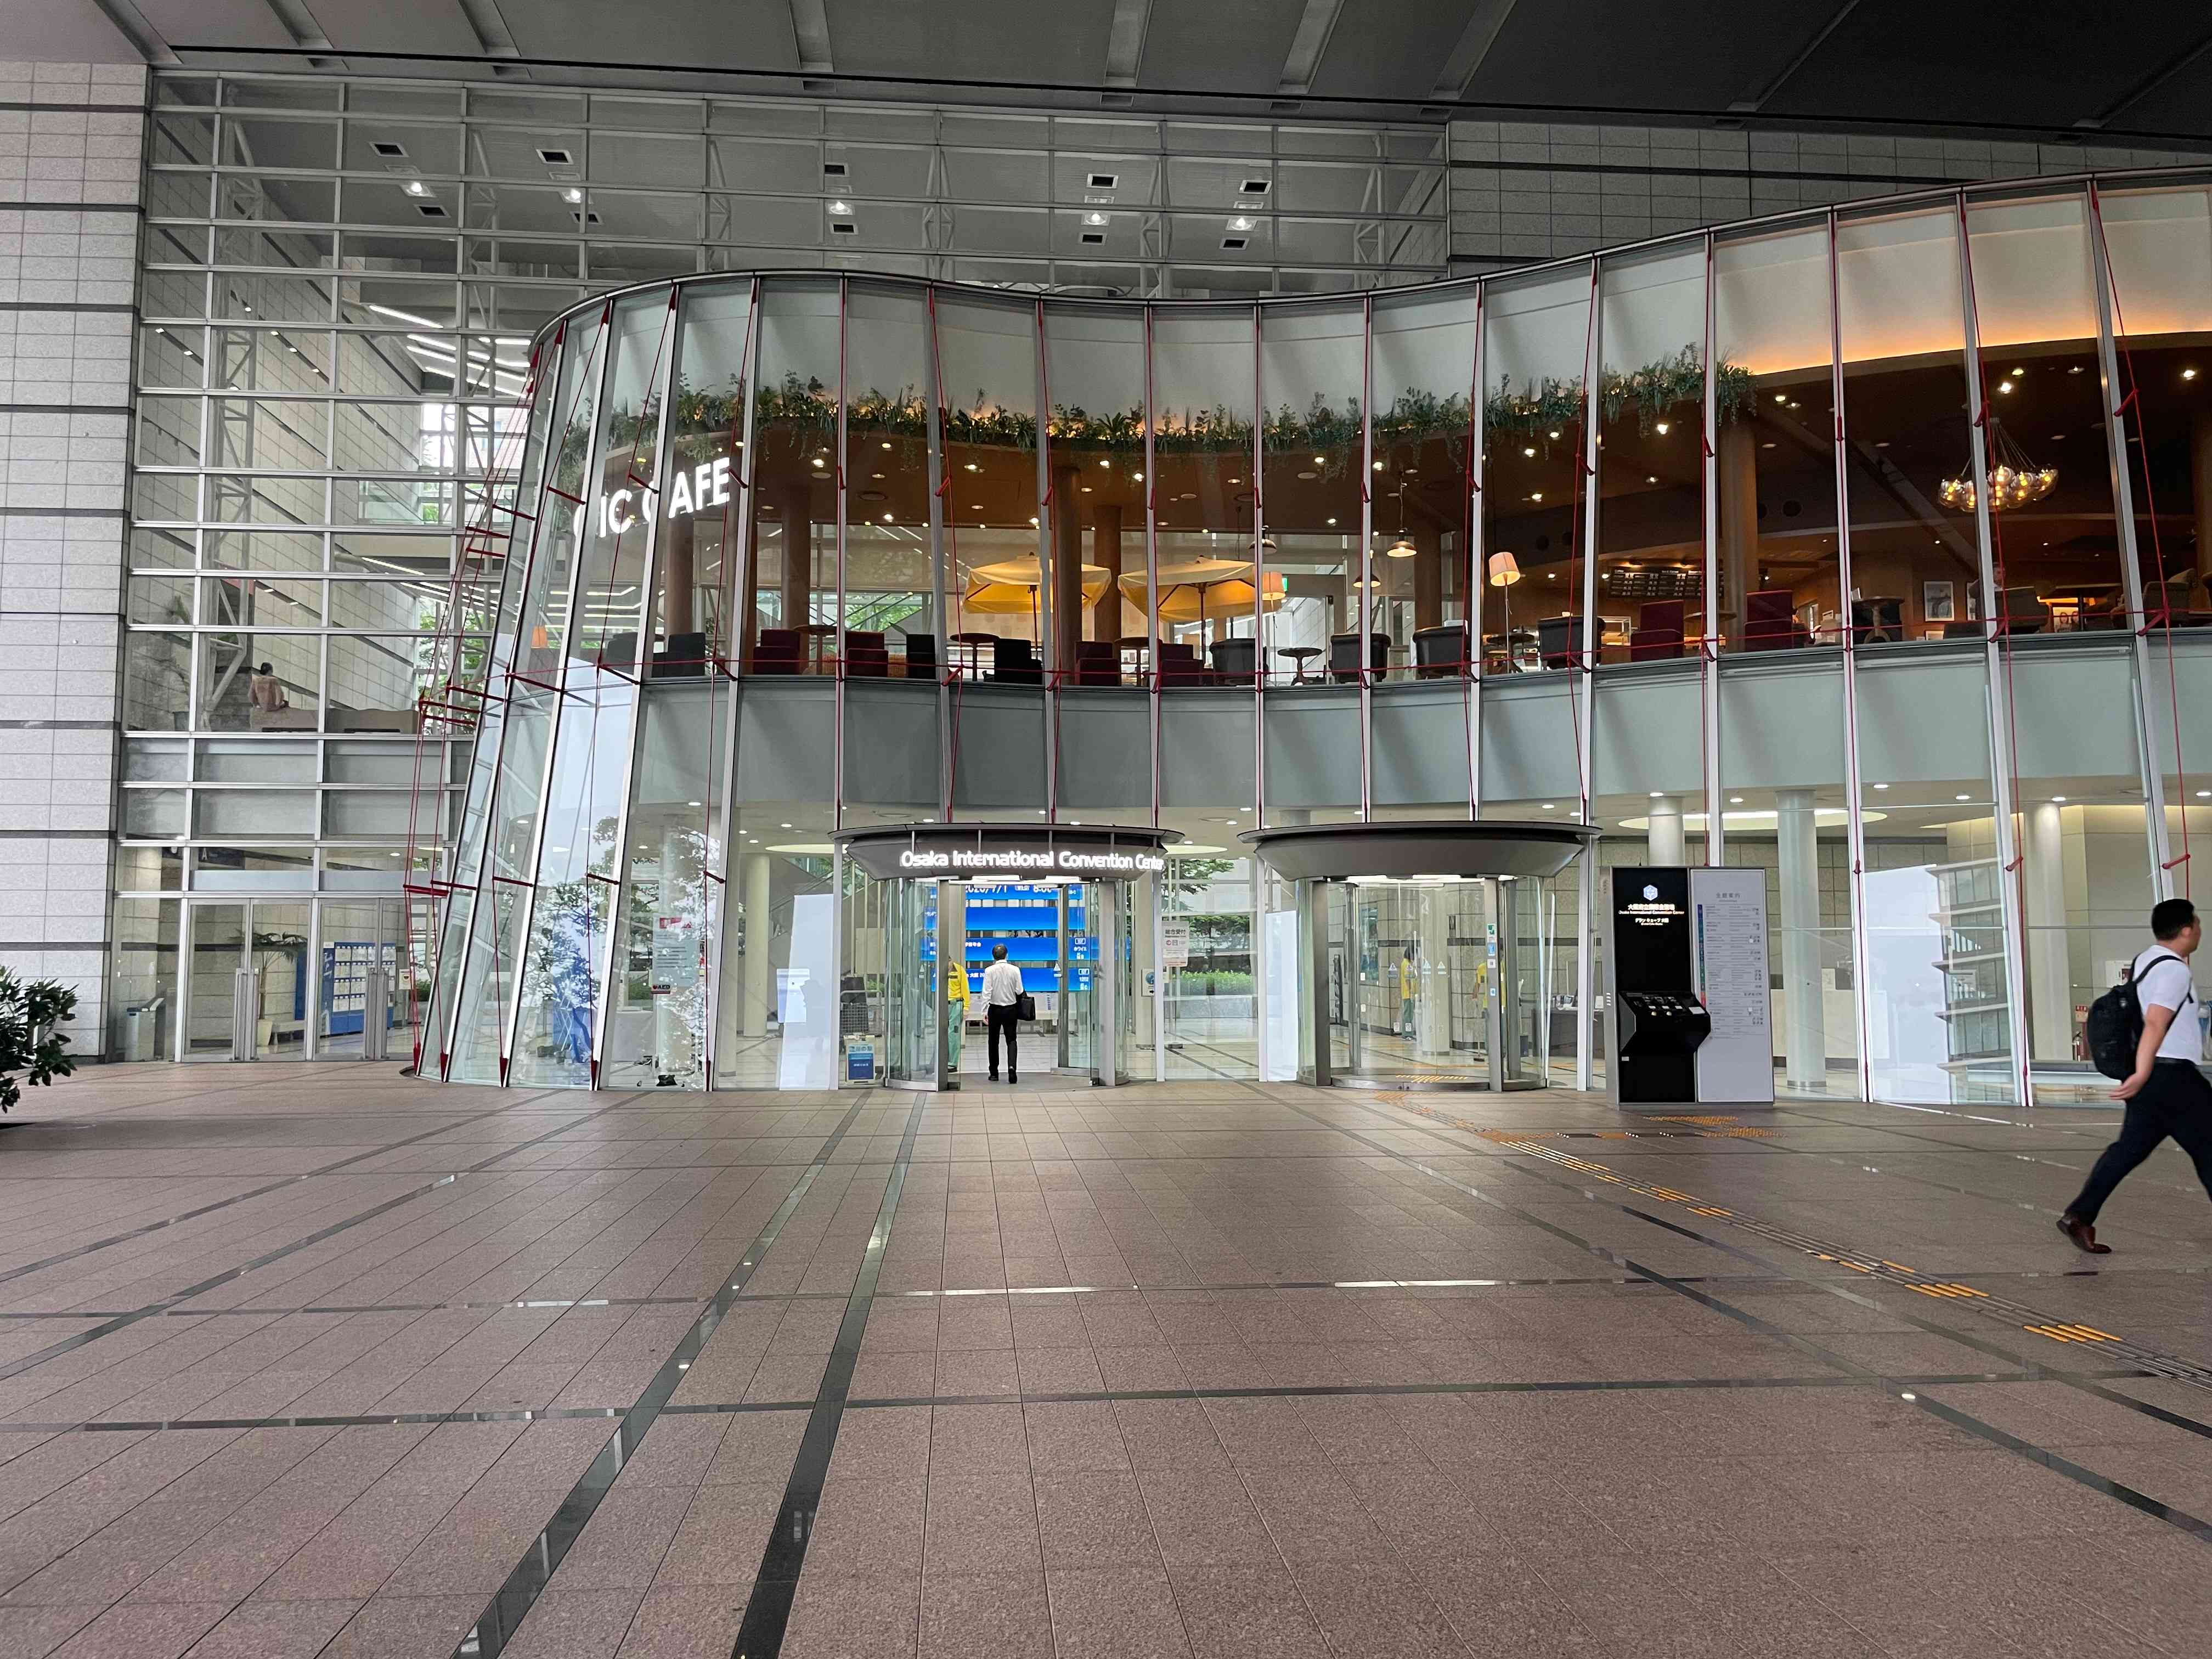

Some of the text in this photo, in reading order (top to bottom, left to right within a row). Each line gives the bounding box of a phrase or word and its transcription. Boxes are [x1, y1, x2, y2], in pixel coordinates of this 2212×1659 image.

[901, 850, 949, 867] Osaka
[952, 850, 1054, 867] International
[1059, 851, 1133, 869] Convention
